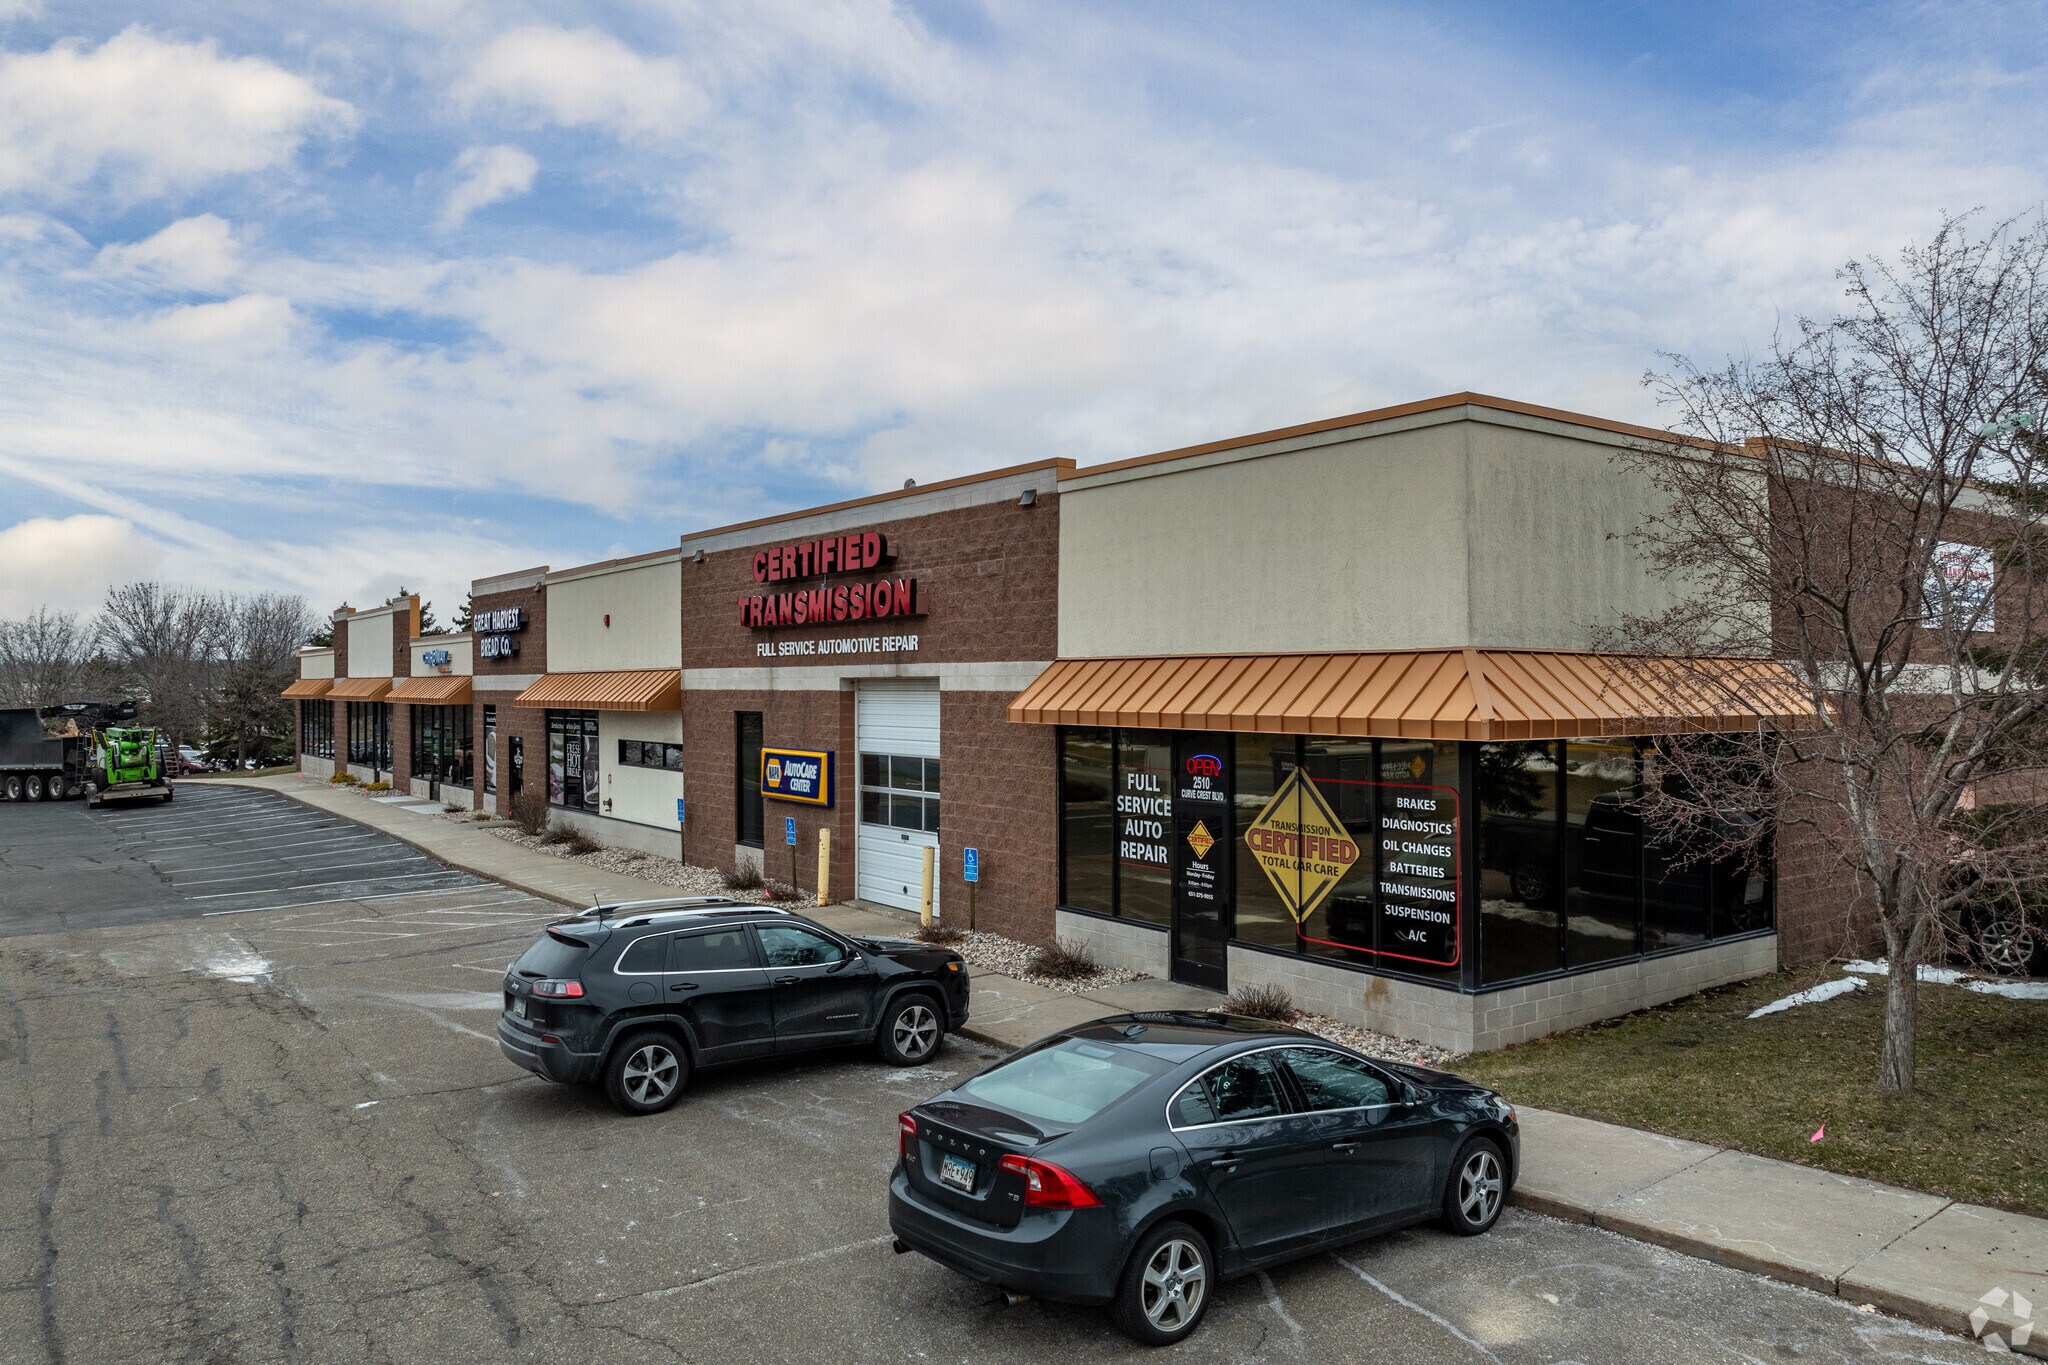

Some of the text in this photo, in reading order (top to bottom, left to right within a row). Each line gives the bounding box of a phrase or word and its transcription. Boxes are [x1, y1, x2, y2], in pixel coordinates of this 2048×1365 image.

[753, 532, 883, 583] CERTIFIED
[738, 577, 913, 627] TRANSMISSION
[474, 608, 520, 632] GREAT HARVEST
[481, 636, 512, 658] BREAD CO.
[757, 635, 918, 657] FULL SERVICE AUTOMOTIVE REPAIR
[566, 753, 580, 767] HOT
[1186, 758, 1219, 776] OPEN
[790, 778, 811, 793] CENTER
[1128, 773, 1160, 792] FULL
[1193, 776, 1210, 790] 2510
[1182, 789, 1224, 801] CURVE CREST BLVD
[1117, 795, 1171, 817] SERVICE
[1396, 797, 1437, 812] BRAKES
[1125, 819, 1162, 839] AUTO
[1270, 819, 1331, 836] TRANSMISSION
[1382, 817, 1452, 835] DIAGNOSTICS
[1189, 835, 1213, 845] CERTIFIED
[1247, 827, 1356, 864] CERTIFIED
[1382, 839, 1452, 857] OIL CHANGES
[1121, 841, 1168, 864] REPAIR
[1192, 861, 1209, 871] Hours
[1262, 855, 1339, 877] TOTAL CAR CARE
[1390, 861, 1445, 878] BATTERIES
[1380, 881, 1456, 902] TRANSMISSIONS
[1385, 904, 1450, 924] SUSPENSION
[1408, 929, 1427, 942] A/C
[925, 1129, 985, 1155] VOLVO
[960, 1167, 974, 1183] 949
